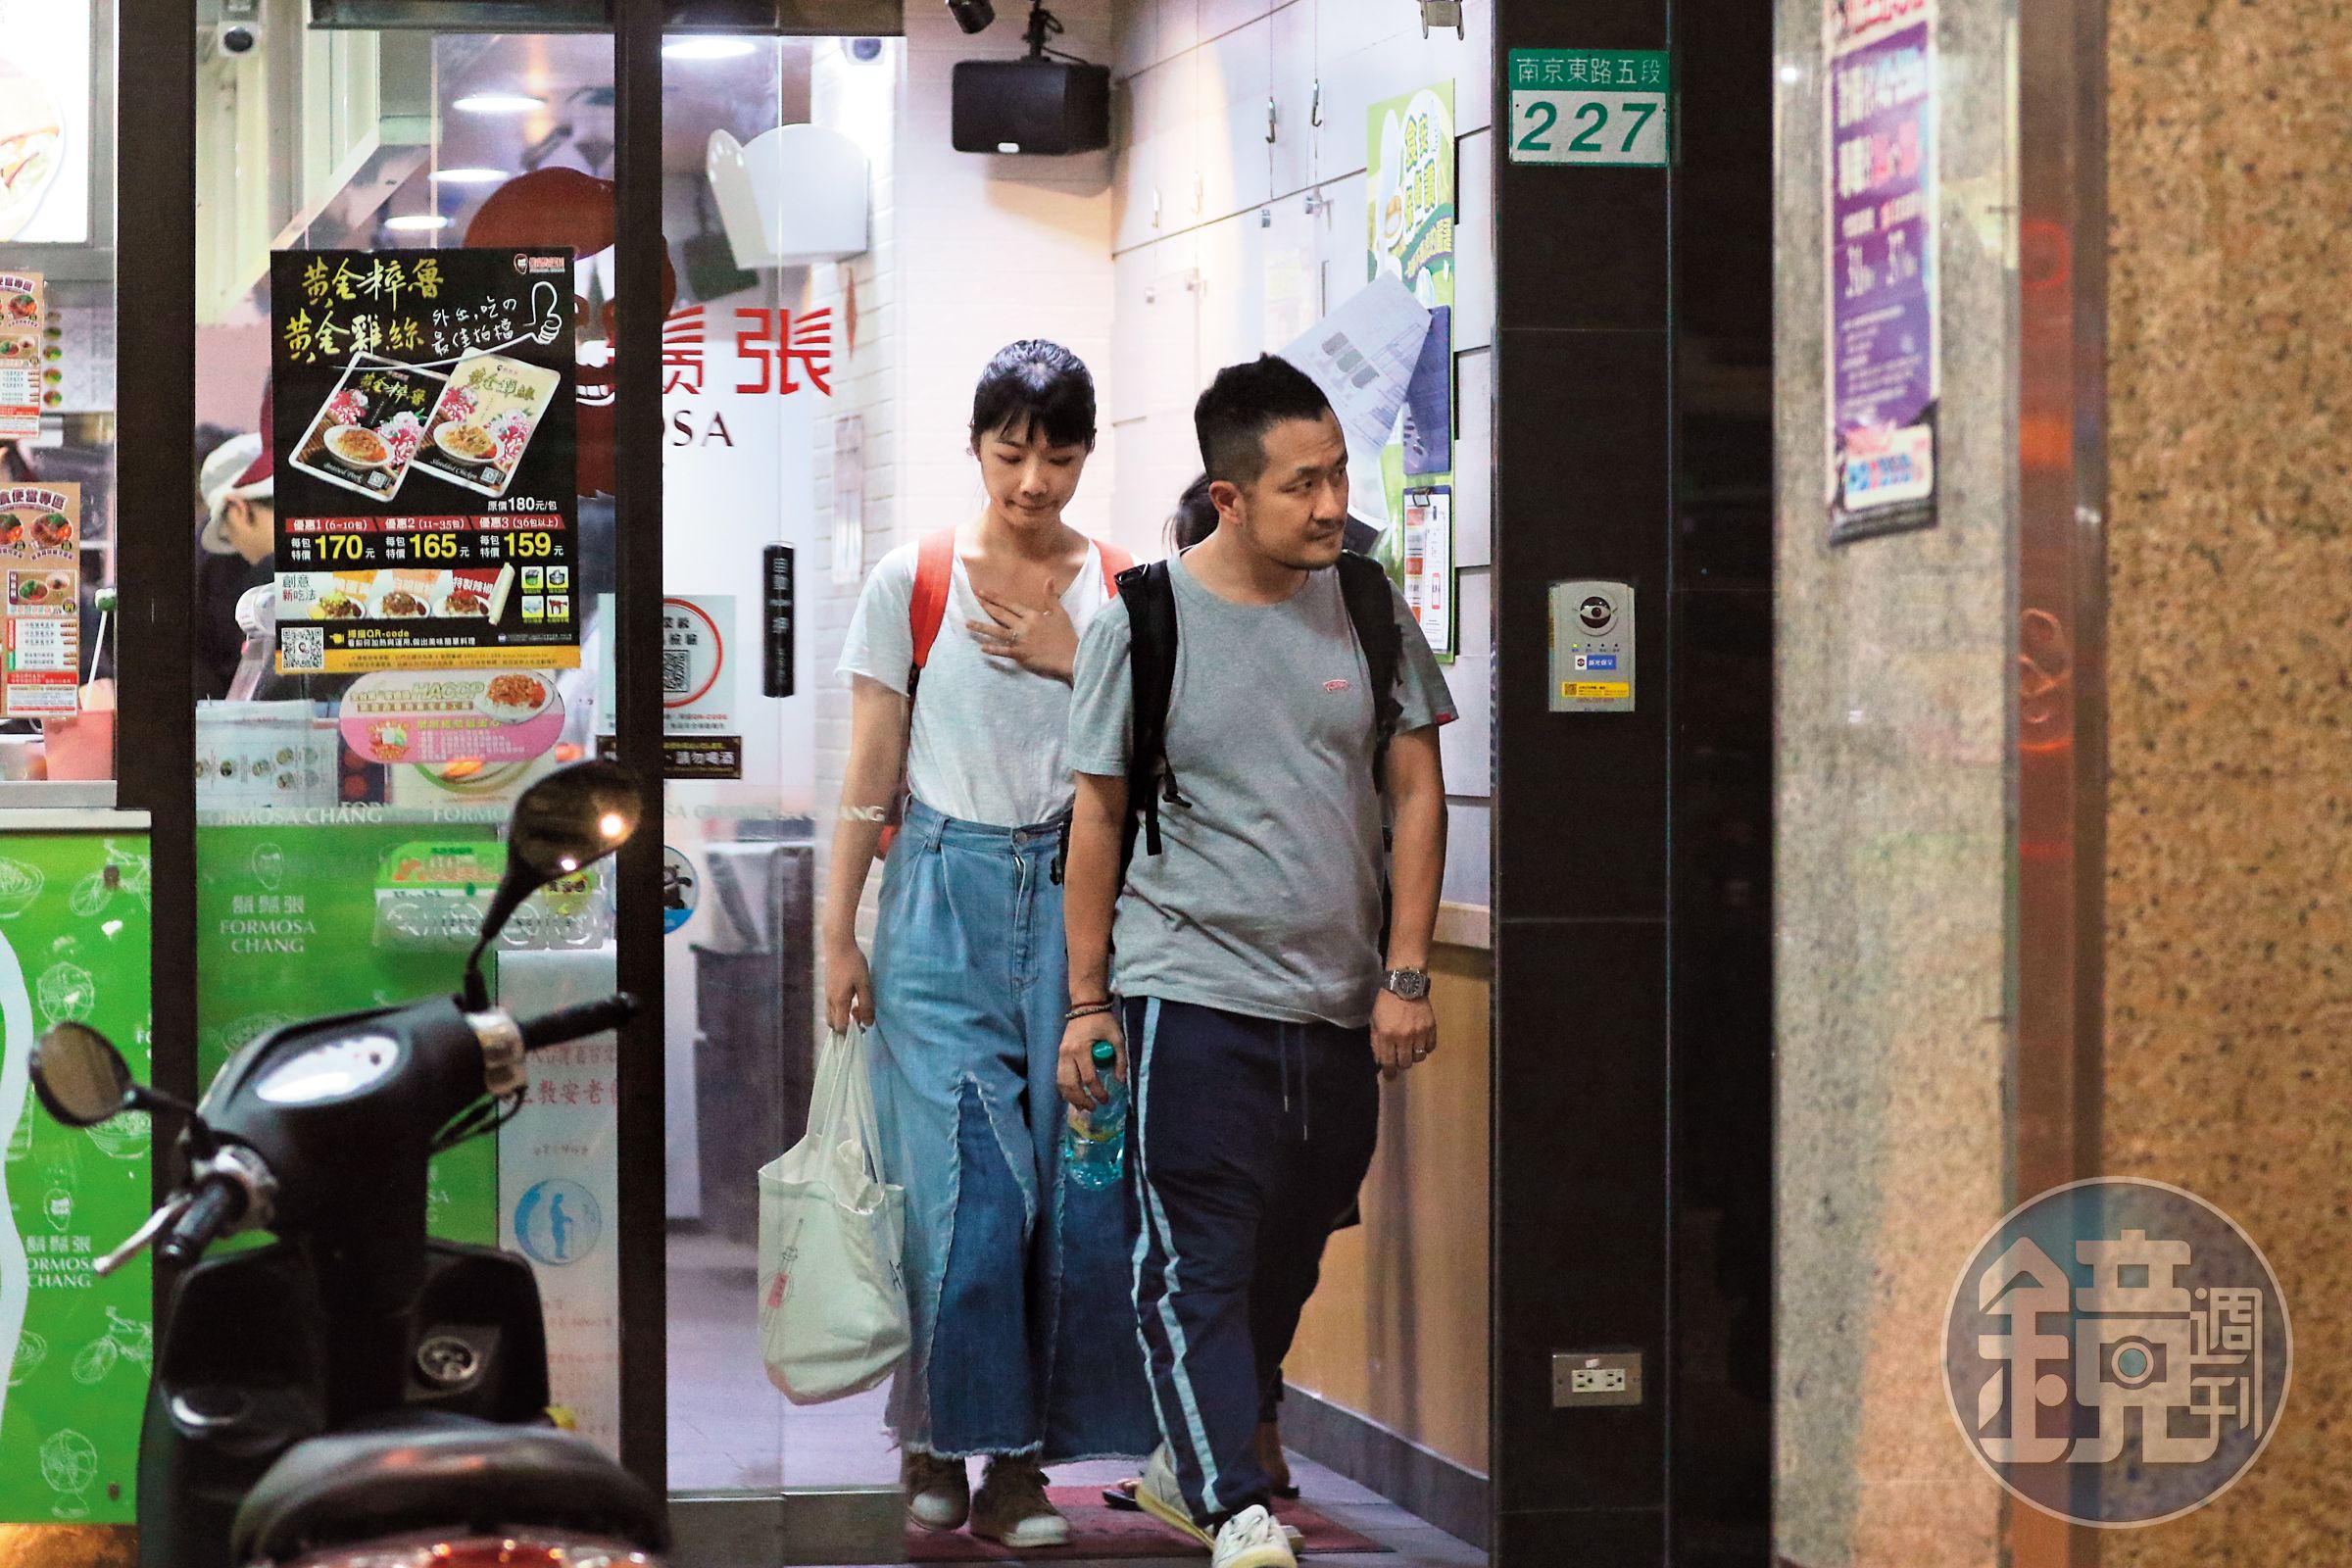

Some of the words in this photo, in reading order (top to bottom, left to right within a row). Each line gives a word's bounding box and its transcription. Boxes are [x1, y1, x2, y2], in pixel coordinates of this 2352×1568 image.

[1516, 57, 1661, 85] 南京東路五段
[1516, 101, 1658, 153] 227
[282, 574, 310, 588] 創意
[282, 590, 316, 603] 新吃法
[305, 808, 382, 823] CHANG
[433, 808, 511, 823] FORMO
[220, 918, 317, 935] FORMOSA
[230, 938, 305, 954] CHANG
